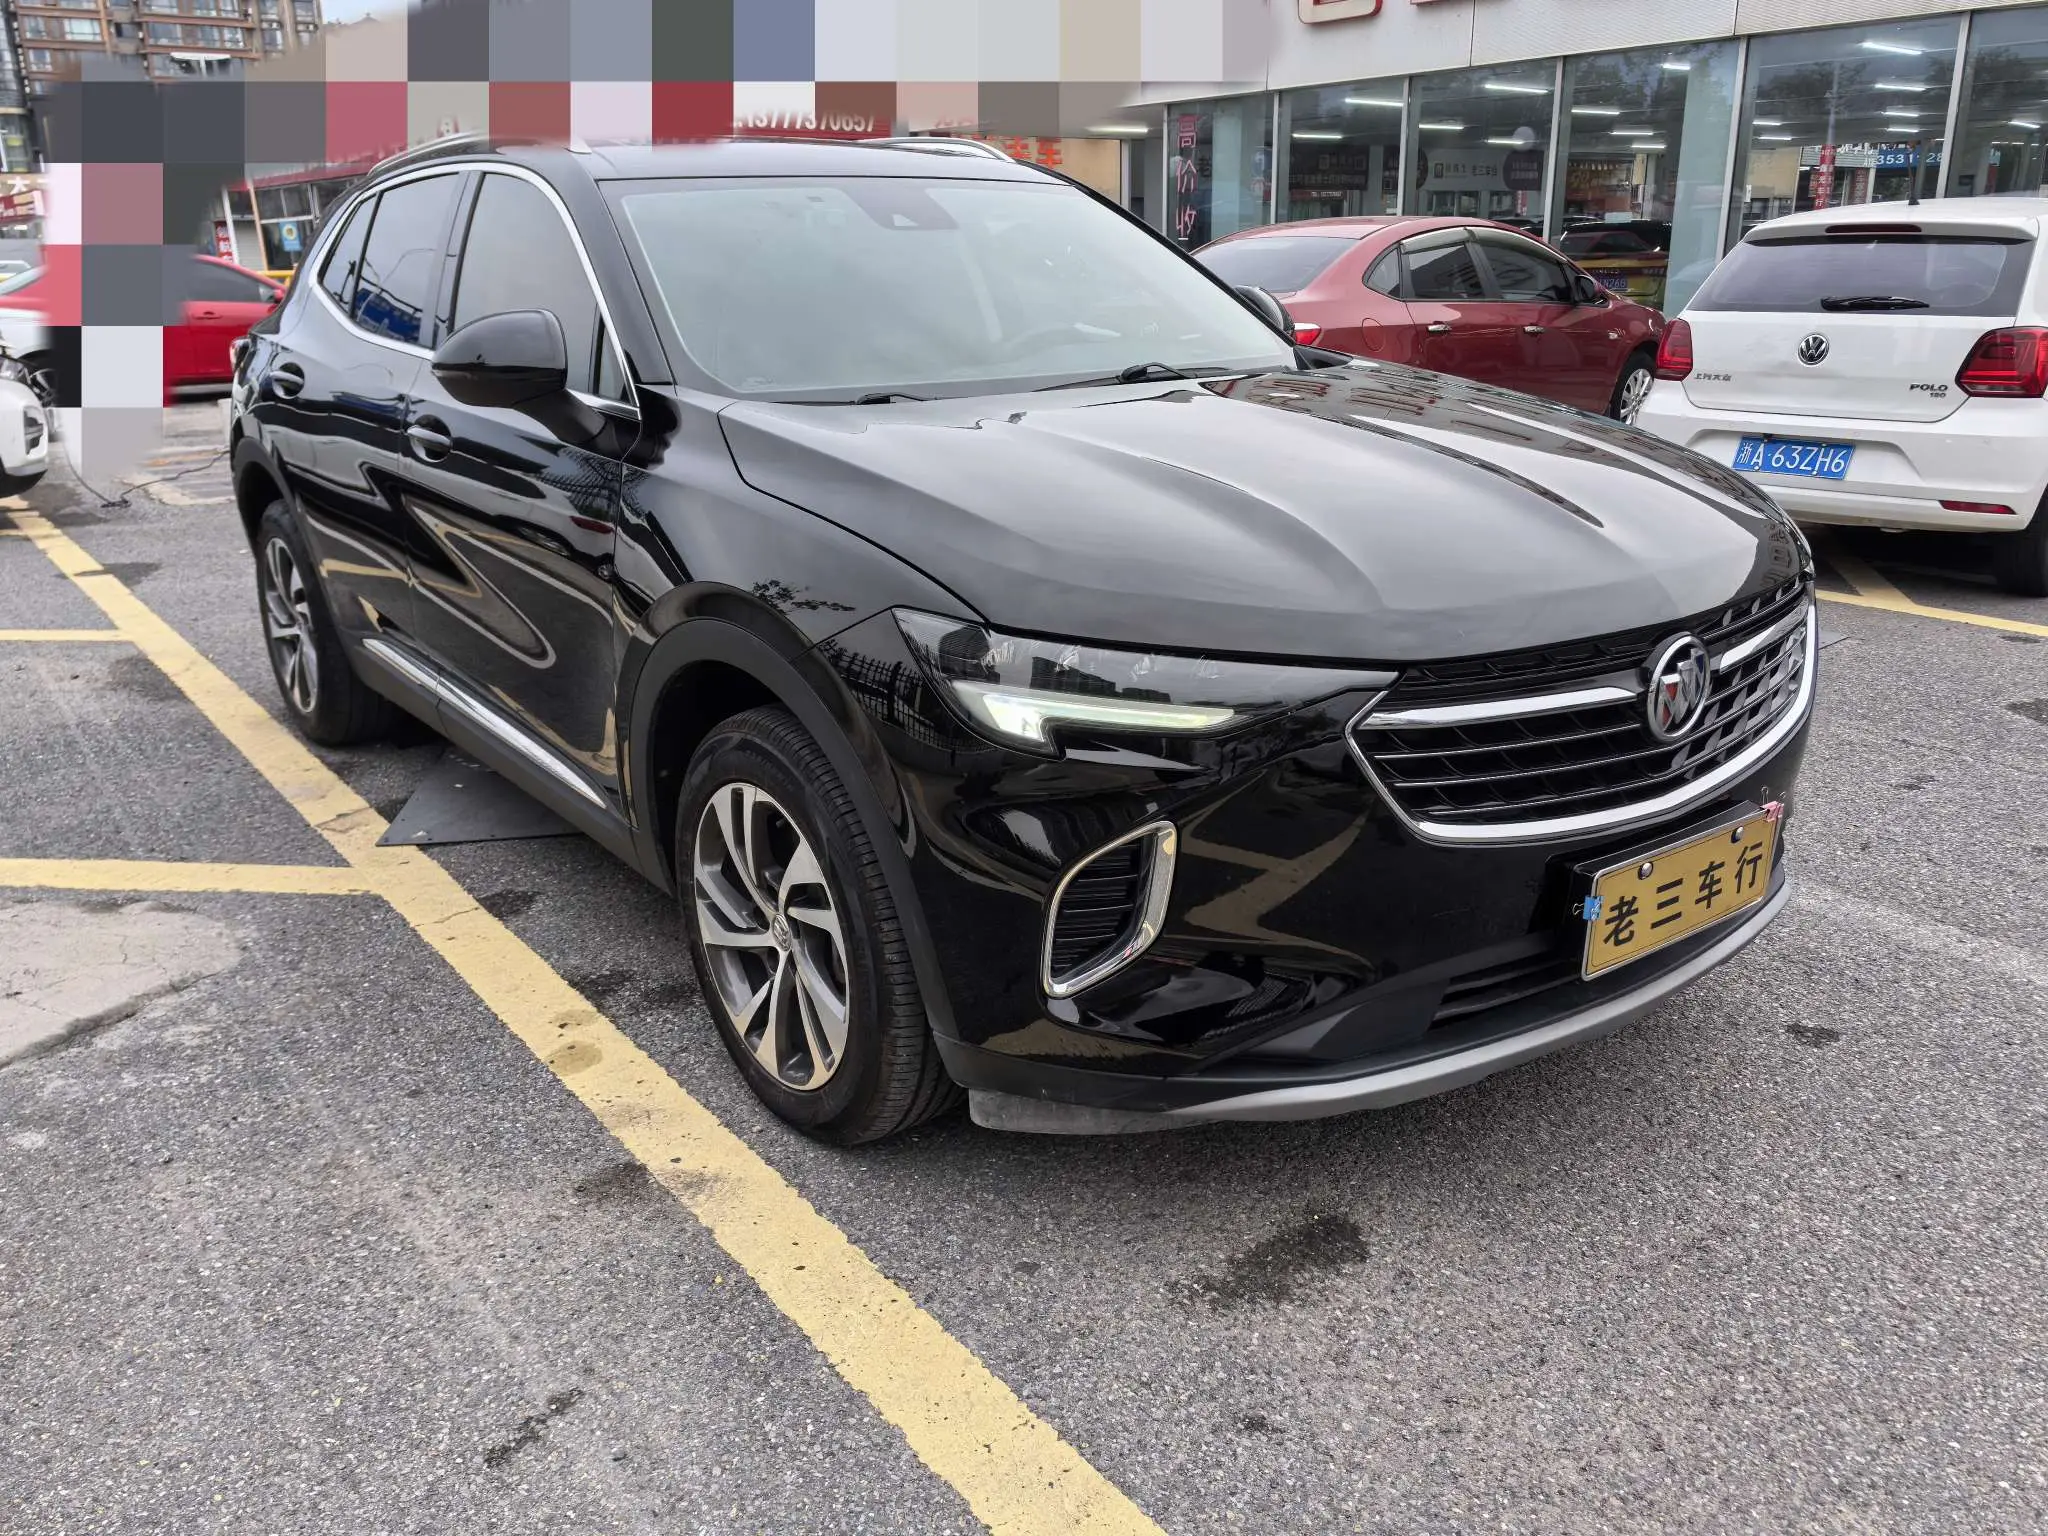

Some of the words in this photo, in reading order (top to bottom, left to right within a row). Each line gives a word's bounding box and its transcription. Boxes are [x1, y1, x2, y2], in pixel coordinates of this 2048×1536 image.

[1909, 383, 1949, 392] POLO
[1603, 840, 1763, 947] 老三车行
